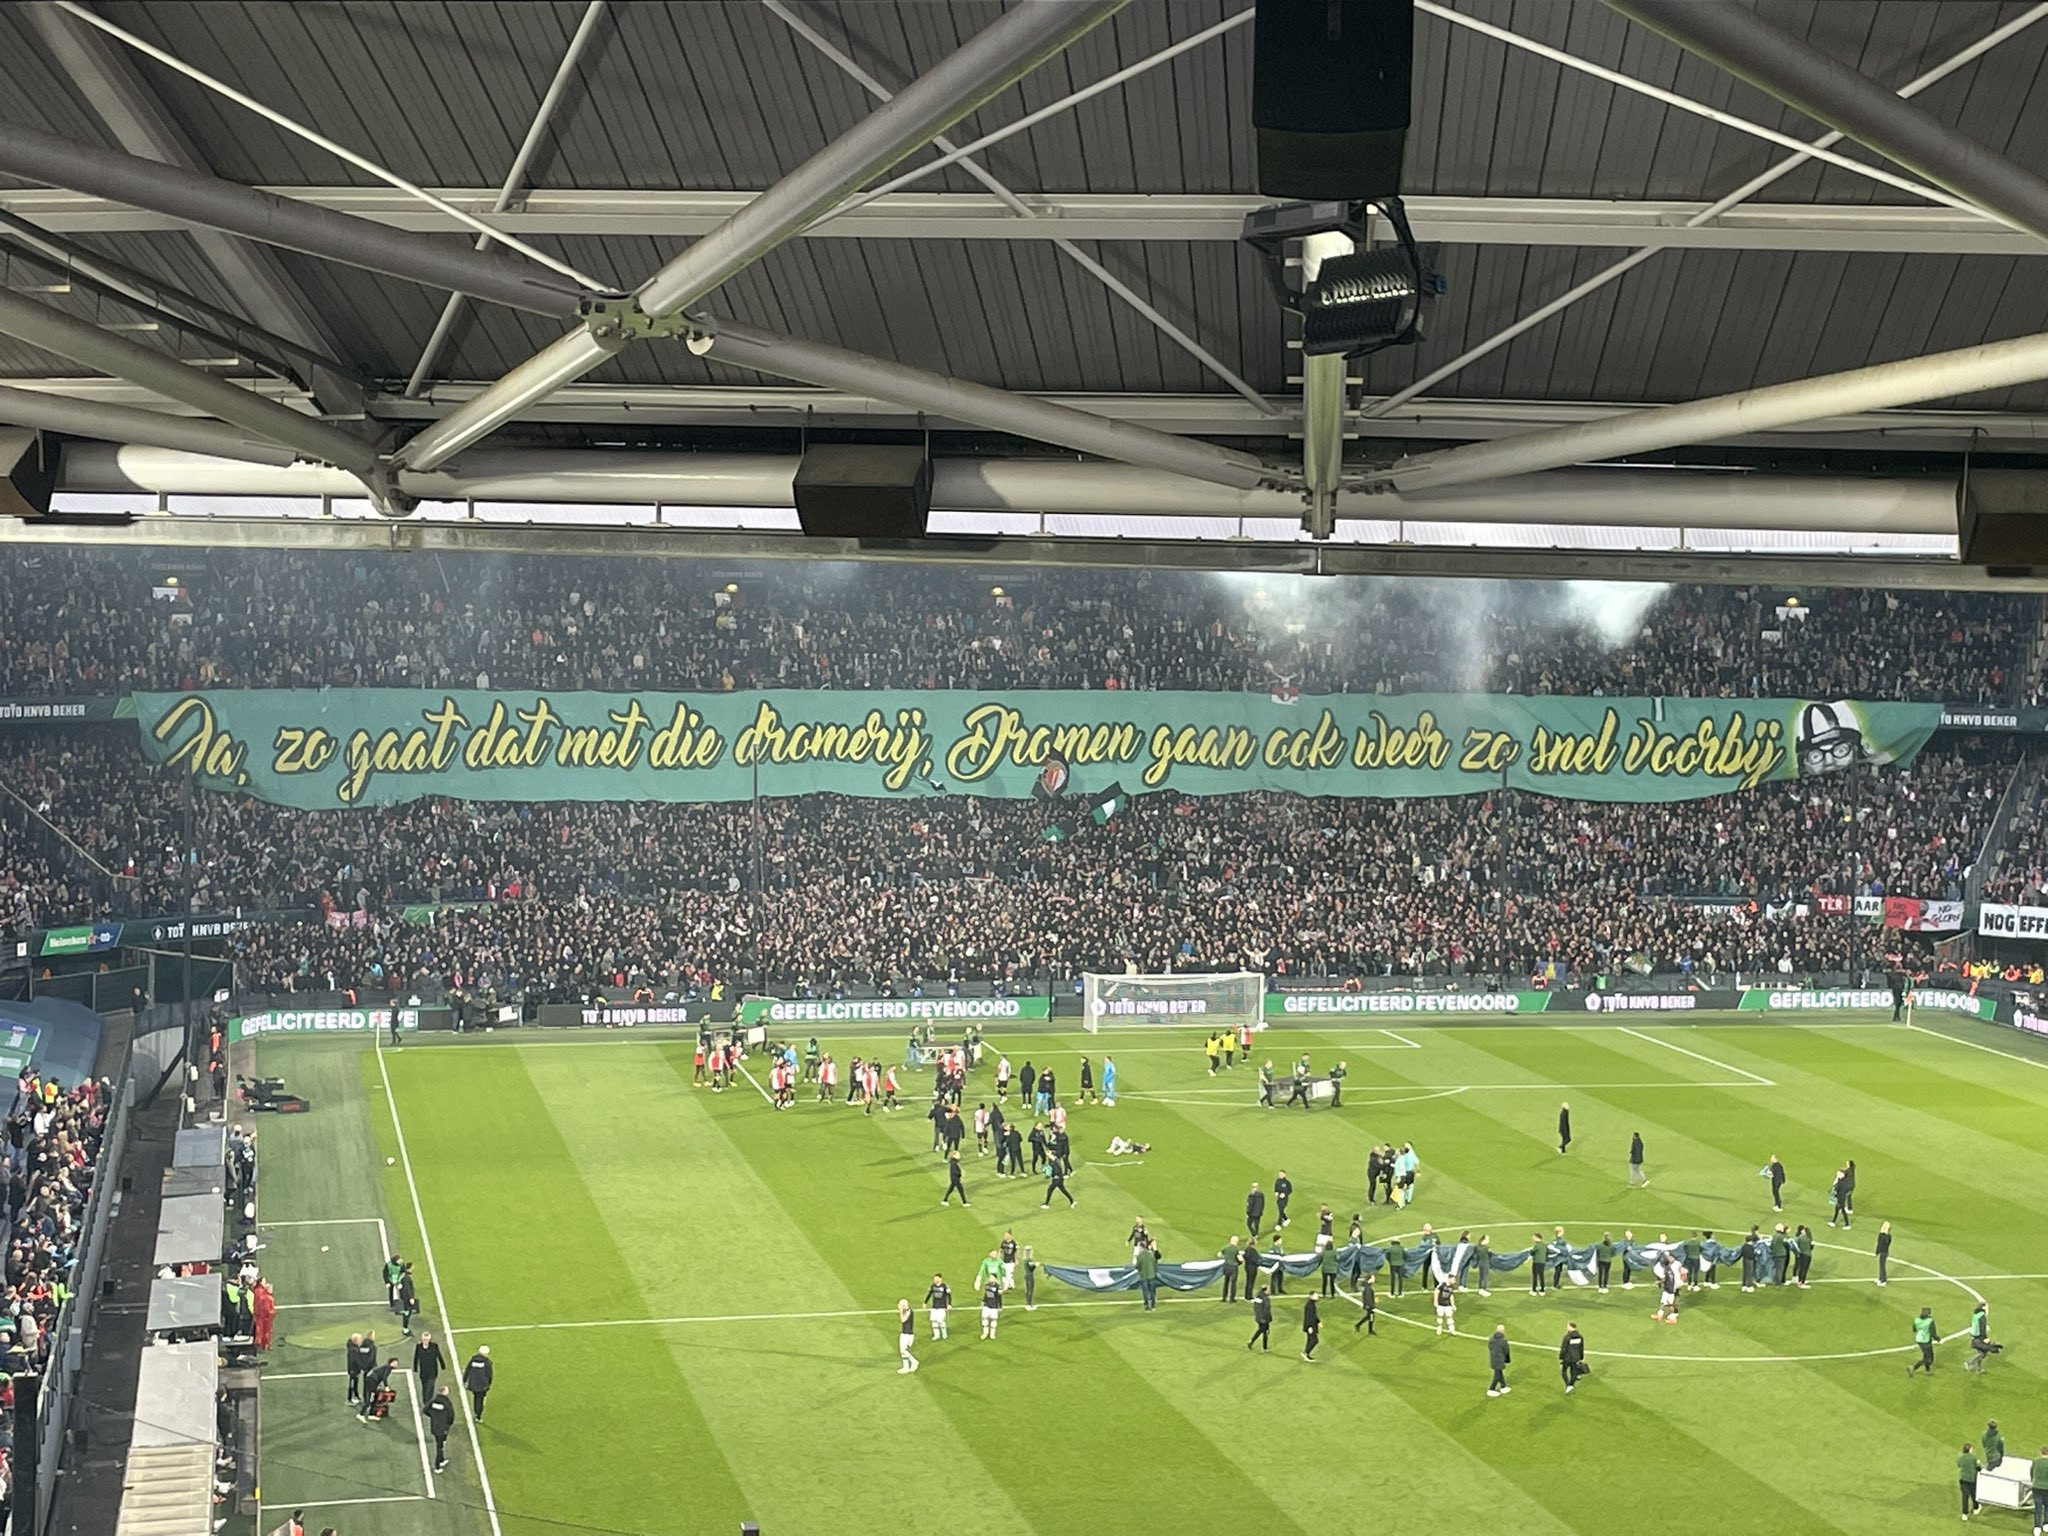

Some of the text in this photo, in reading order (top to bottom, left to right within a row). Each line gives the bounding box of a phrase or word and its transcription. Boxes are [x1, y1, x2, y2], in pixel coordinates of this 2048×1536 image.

[53, 704, 85, 716] BEKER
[273, 728, 337, 773] zo
[338, 698, 468, 802] gaat
[464, 698, 561, 768] dat
[556, 699, 655, 768] met
[648, 701, 724, 768] die
[946, 703, 1143, 781] Dromen
[1143, 724, 1257, 785] gaan
[1264, 709, 1344, 768] ook
[1459, 728, 1519, 771] zo
[1529, 708, 1617, 773] snel
[1622, 712, 1783, 791] voorbij
[167, 923, 185, 939] TOT
[1984, 912, 2015, 933] NOG
[1284, 994, 1519, 1013] GEFELICITEERD FEYENOORD
[1769, 991, 1895, 1009] GEFELICITEERD
[770, 1000, 1020, 1021] GEFELICITEERD FEYENOORD
[241, 1012, 366, 1036] GEFELICITEERD
